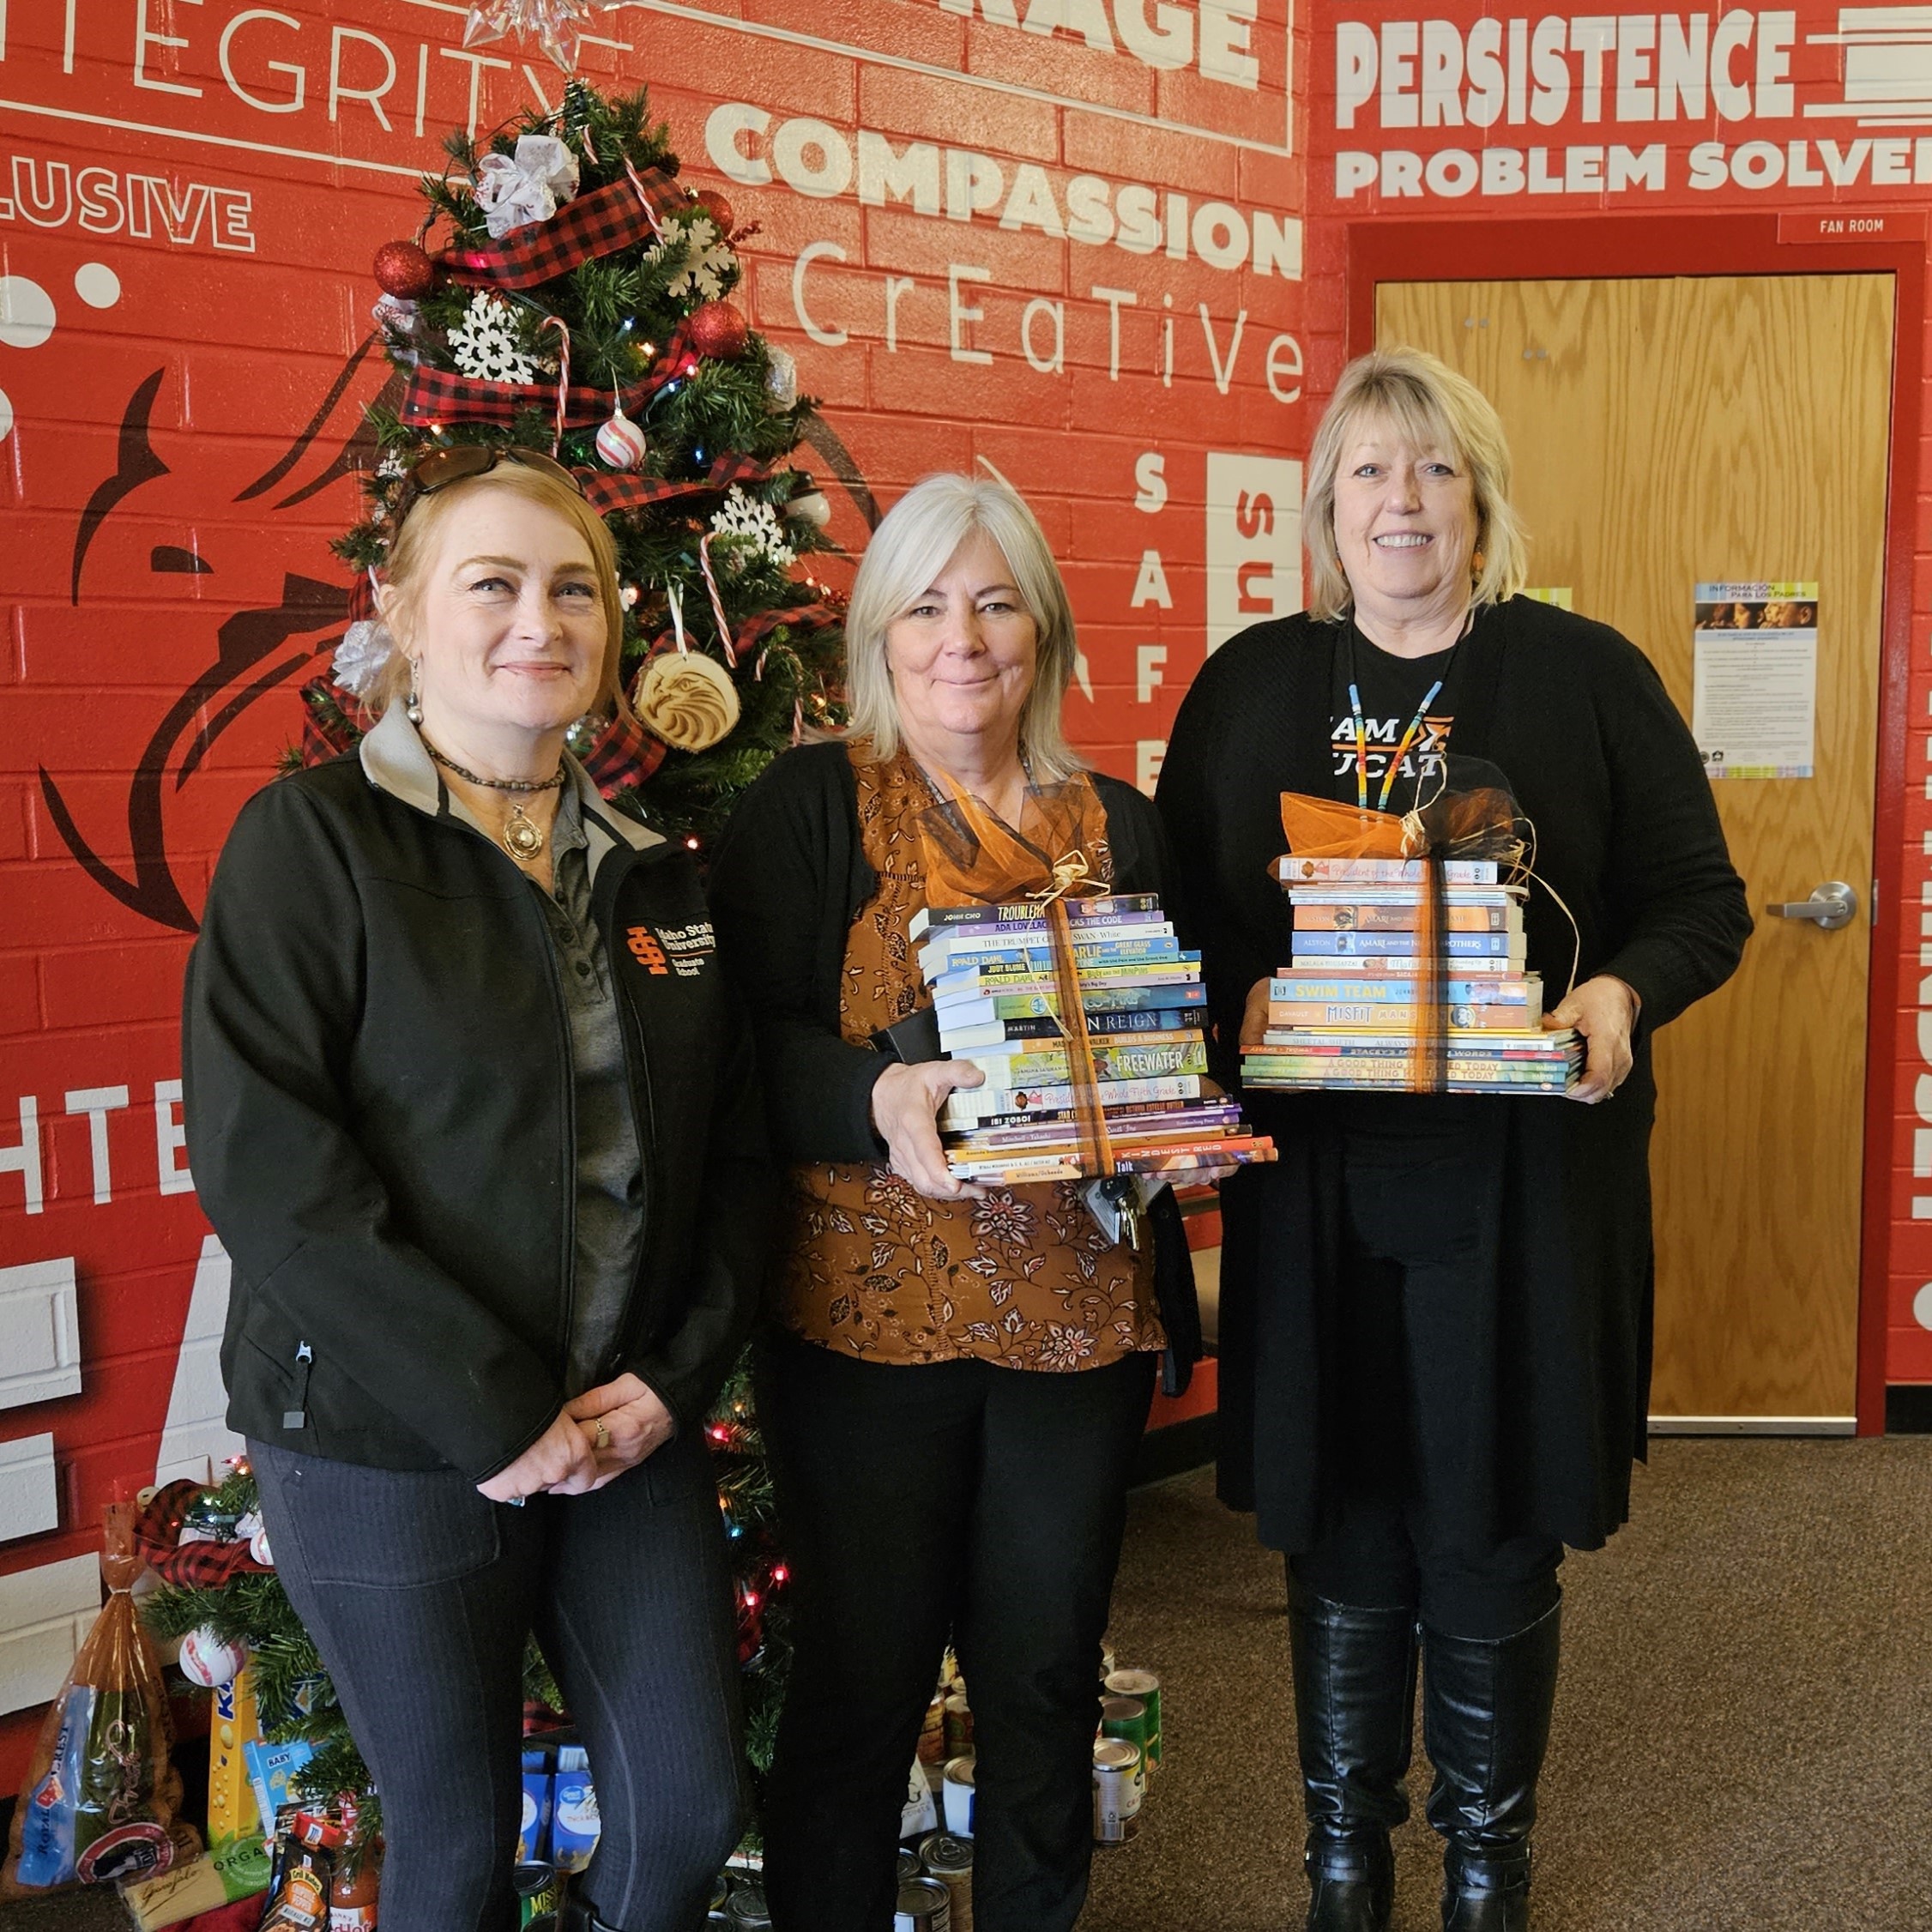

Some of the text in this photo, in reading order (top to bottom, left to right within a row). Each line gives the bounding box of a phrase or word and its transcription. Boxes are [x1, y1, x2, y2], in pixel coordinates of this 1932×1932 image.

[1336, 9, 1796, 130] PERSISTENCE
[1335, 144, 1667, 198] PROBLEM
[703, 102, 1304, 281] COMPASSION
[0, 155, 256, 252] USIVE
[1820, 219, 1884, 233] FAN ROOM
[791, 240, 1304, 404] CrEaTiVe
[1446, 869, 1471, 881] Grade
[995, 923, 1011, 932] ADA
[1085, 916, 1100, 926] THE
[1102, 915, 1123, 924] CODE
[655, 927, 687, 941] Idaho
[661, 933, 716, 951] University
[982, 939, 1001, 948] THE
[1003, 936, 1041, 946] TRUMPET
[1360, 939, 1386, 949] AMARI
[951, 956, 979, 968] ROALD
[981, 954, 1005, 964] DAHL
[984, 975, 1011, 986] ROALD
[1295, 984, 1387, 998] SWIM TEAM
[1106, 1011, 1157, 1029] REIGN
[1325, 1005, 1374, 1024] MISFIT
[1116, 1051, 1185, 1072] FREEWATER
[1337, 1060, 1367, 1068] GOOD
[1372, 1060, 1404, 1069] THING
[1465, 1062, 1499, 1071] TODAY
[1367, 1069, 1399, 1078] THING
[1461, 1071, 1494, 1079] TODAY
[1105, 1088, 1130, 1100] Whole
[1152, 1085, 1176, 1099] Grade
[1121, 1144, 1222, 1158] KINDEST RED
[1116, 1161, 1134, 1174] Talk
[268, 1753, 292, 1769] BABY
[37, 1808, 51, 1856] ROYAL
